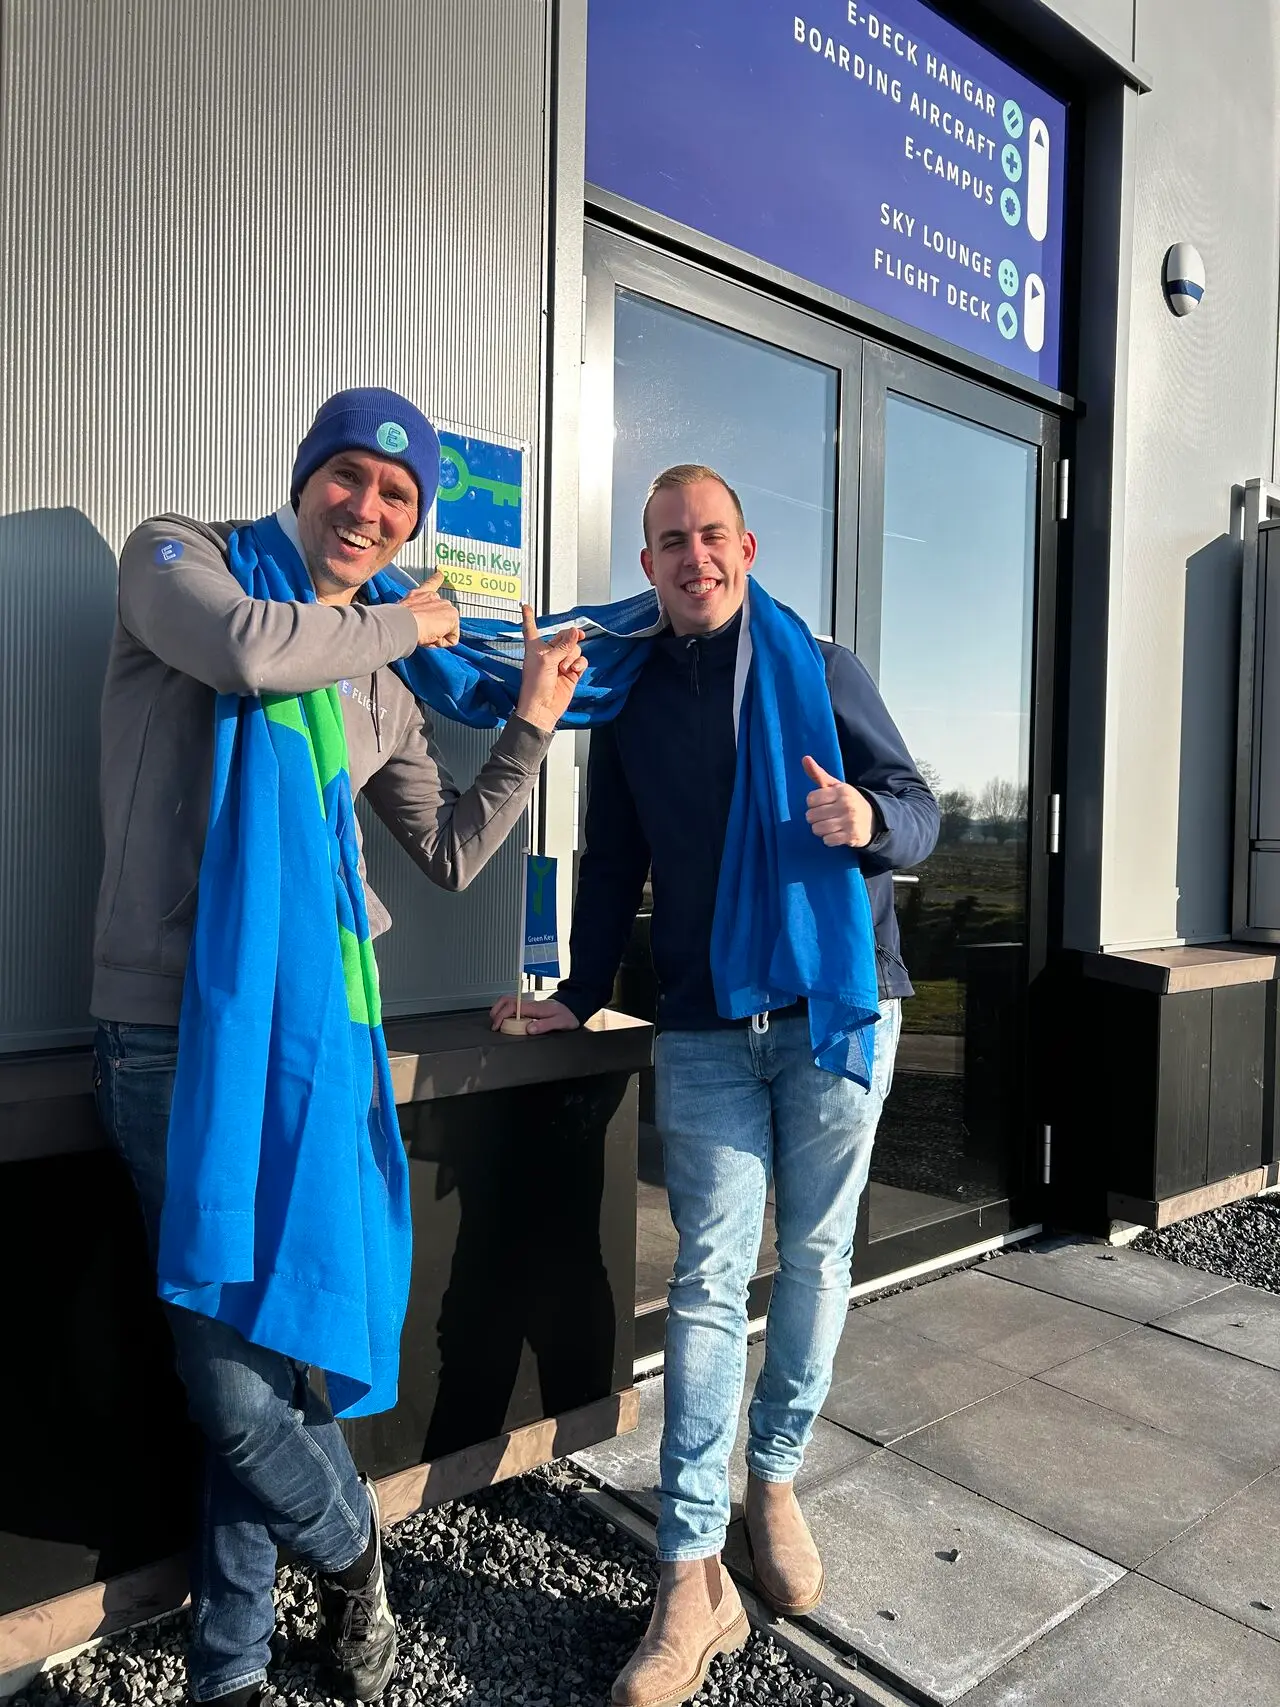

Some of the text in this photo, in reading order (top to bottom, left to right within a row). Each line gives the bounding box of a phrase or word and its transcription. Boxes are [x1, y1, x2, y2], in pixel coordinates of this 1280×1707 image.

[794, 16, 996, 161] BOARDING AIRCRAFT
[847, 0, 996, 118] E-DECK HANGAR
[905, 135, 994, 206] E-CAMPUS
[880, 203, 992, 279] SKY LOUNGE
[874, 248, 991, 323] FLIGHT DECK
[160, 544, 176, 561] E
[435, 542, 521, 577] Green Key
[442, 570, 516, 594] 2025 GOUD
[527, 934, 555, 943] Green Key
